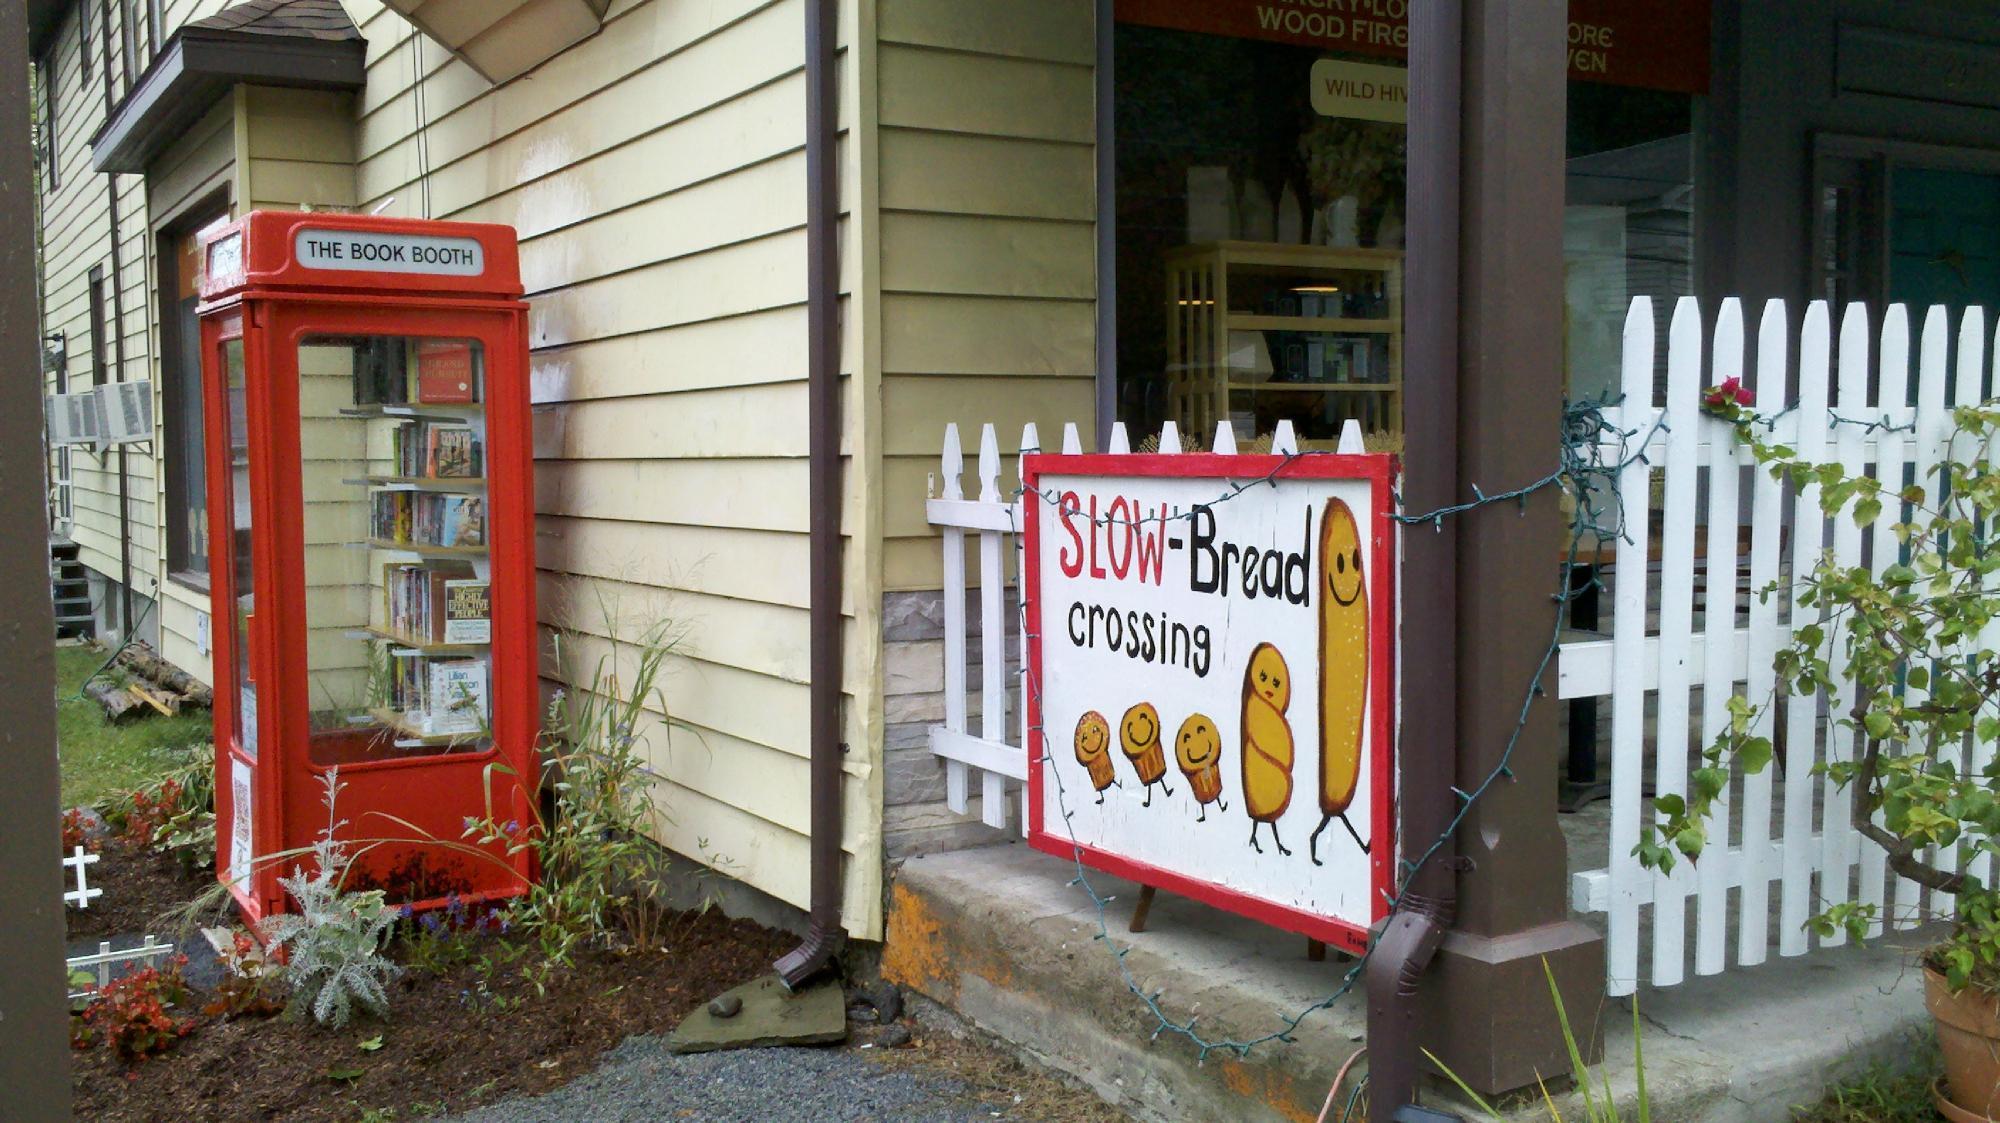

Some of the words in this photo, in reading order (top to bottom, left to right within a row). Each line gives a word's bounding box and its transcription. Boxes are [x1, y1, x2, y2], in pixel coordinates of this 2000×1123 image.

[1255, 5, 1345, 39] WOOD
[1351, 19, 1408, 48] FIRE
[1566, 48, 1607, 74] EN
[1567, 22, 1614, 48] ORE
[1324, 78, 1375, 99] WILD
[1380, 83, 1408, 103] HIV
[306, 240, 343, 259] THE
[350, 243, 406, 262] BOOK
[412, 246, 474, 265] BOOTH
[1068, 601, 1211, 678] crossing
